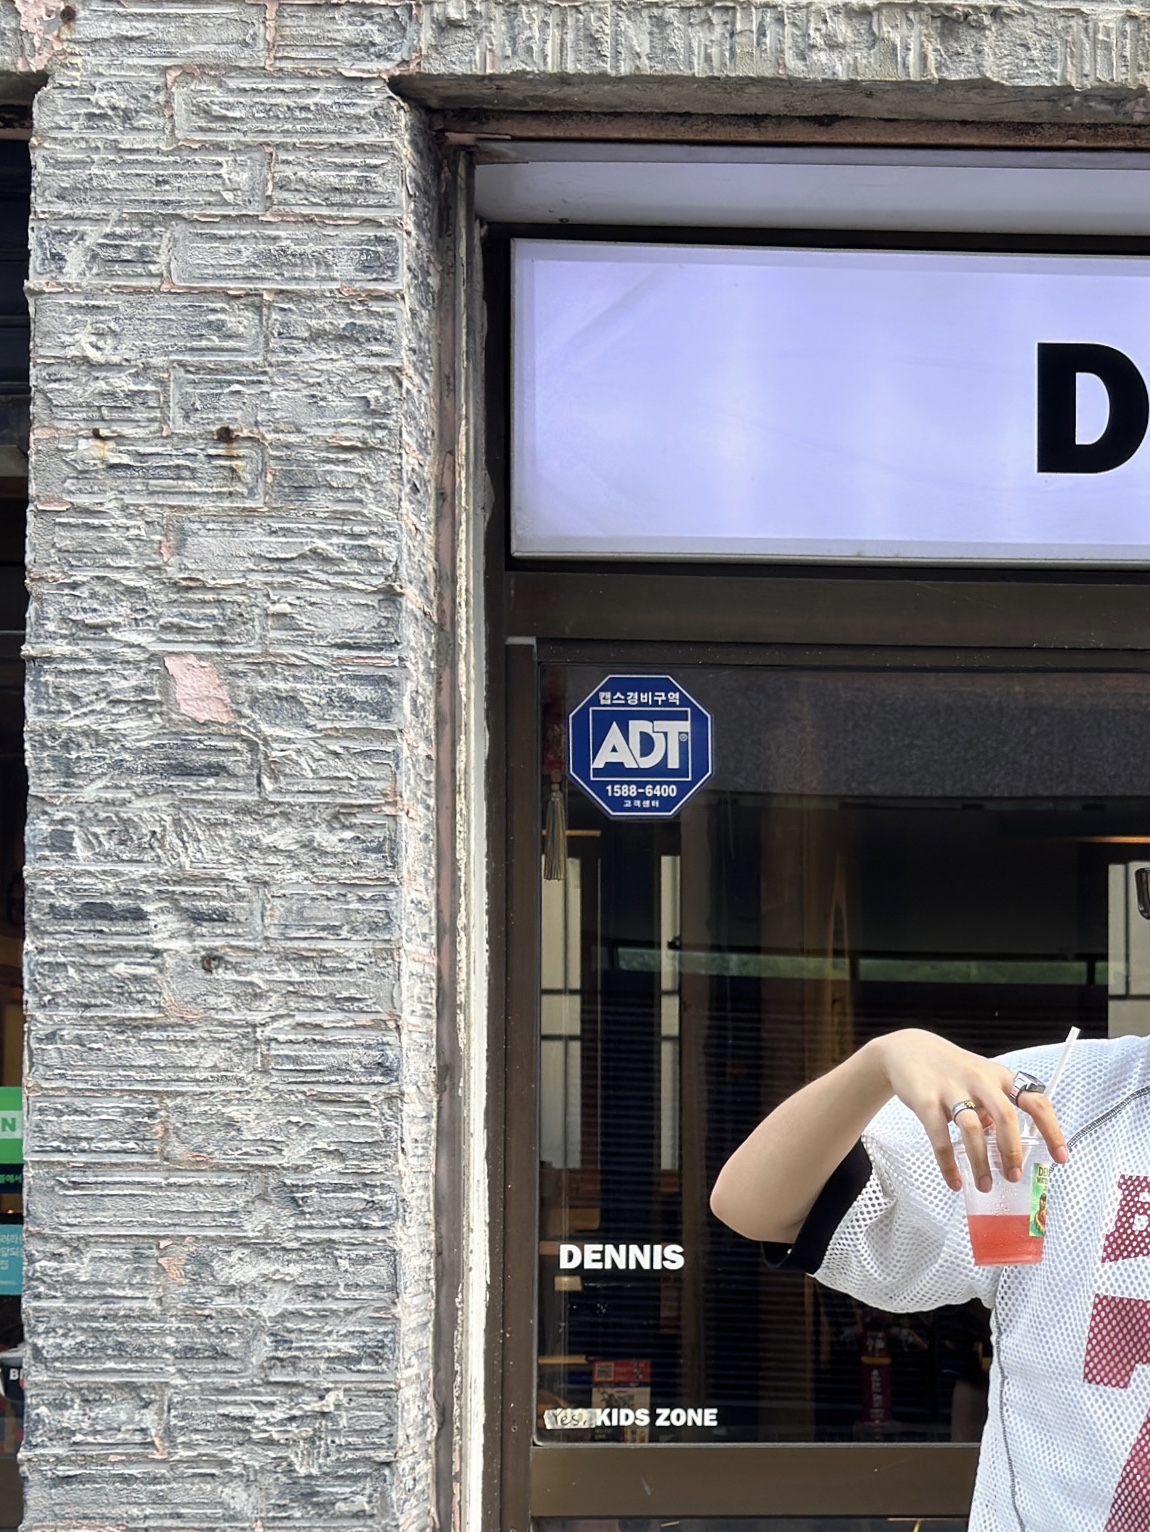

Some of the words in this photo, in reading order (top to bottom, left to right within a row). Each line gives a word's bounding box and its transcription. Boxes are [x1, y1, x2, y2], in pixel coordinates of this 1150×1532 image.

[598, 691, 680, 706] 캡스경비구역
[592, 719, 688, 769] ADT
[606, 784, 678, 798] 1588-6400
[623, 799, 660, 809] 고객센터
[559, 1244, 685, 1270] DENNIS
[596, 1408, 650, 1426] KIDS
[655, 1408, 718, 1427] ZONE
